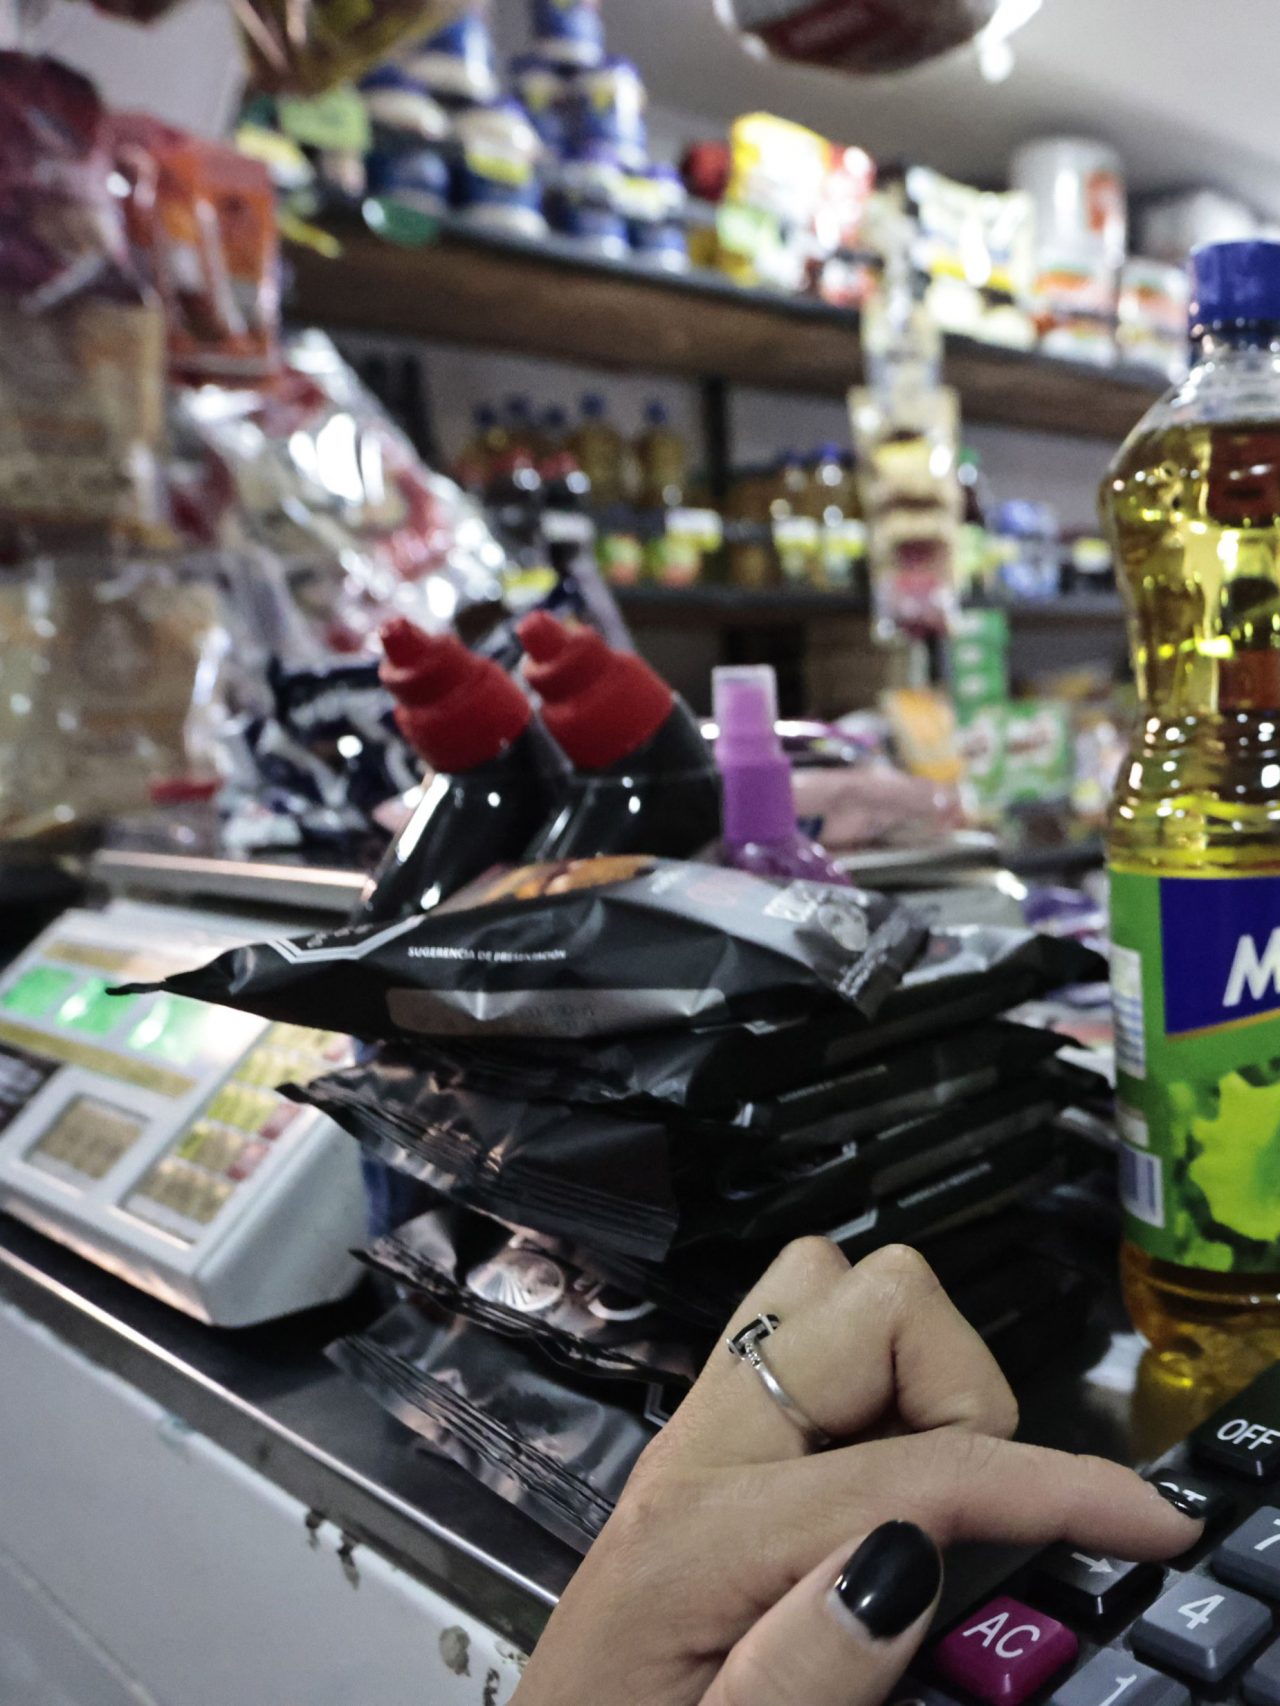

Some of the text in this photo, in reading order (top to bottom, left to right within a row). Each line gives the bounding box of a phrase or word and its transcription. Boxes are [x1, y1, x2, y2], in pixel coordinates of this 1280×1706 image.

[1177, 1593, 1226, 1630] 4
[962, 1611, 1041, 1659] AC
[1099, 1673, 1138, 1706] 1
